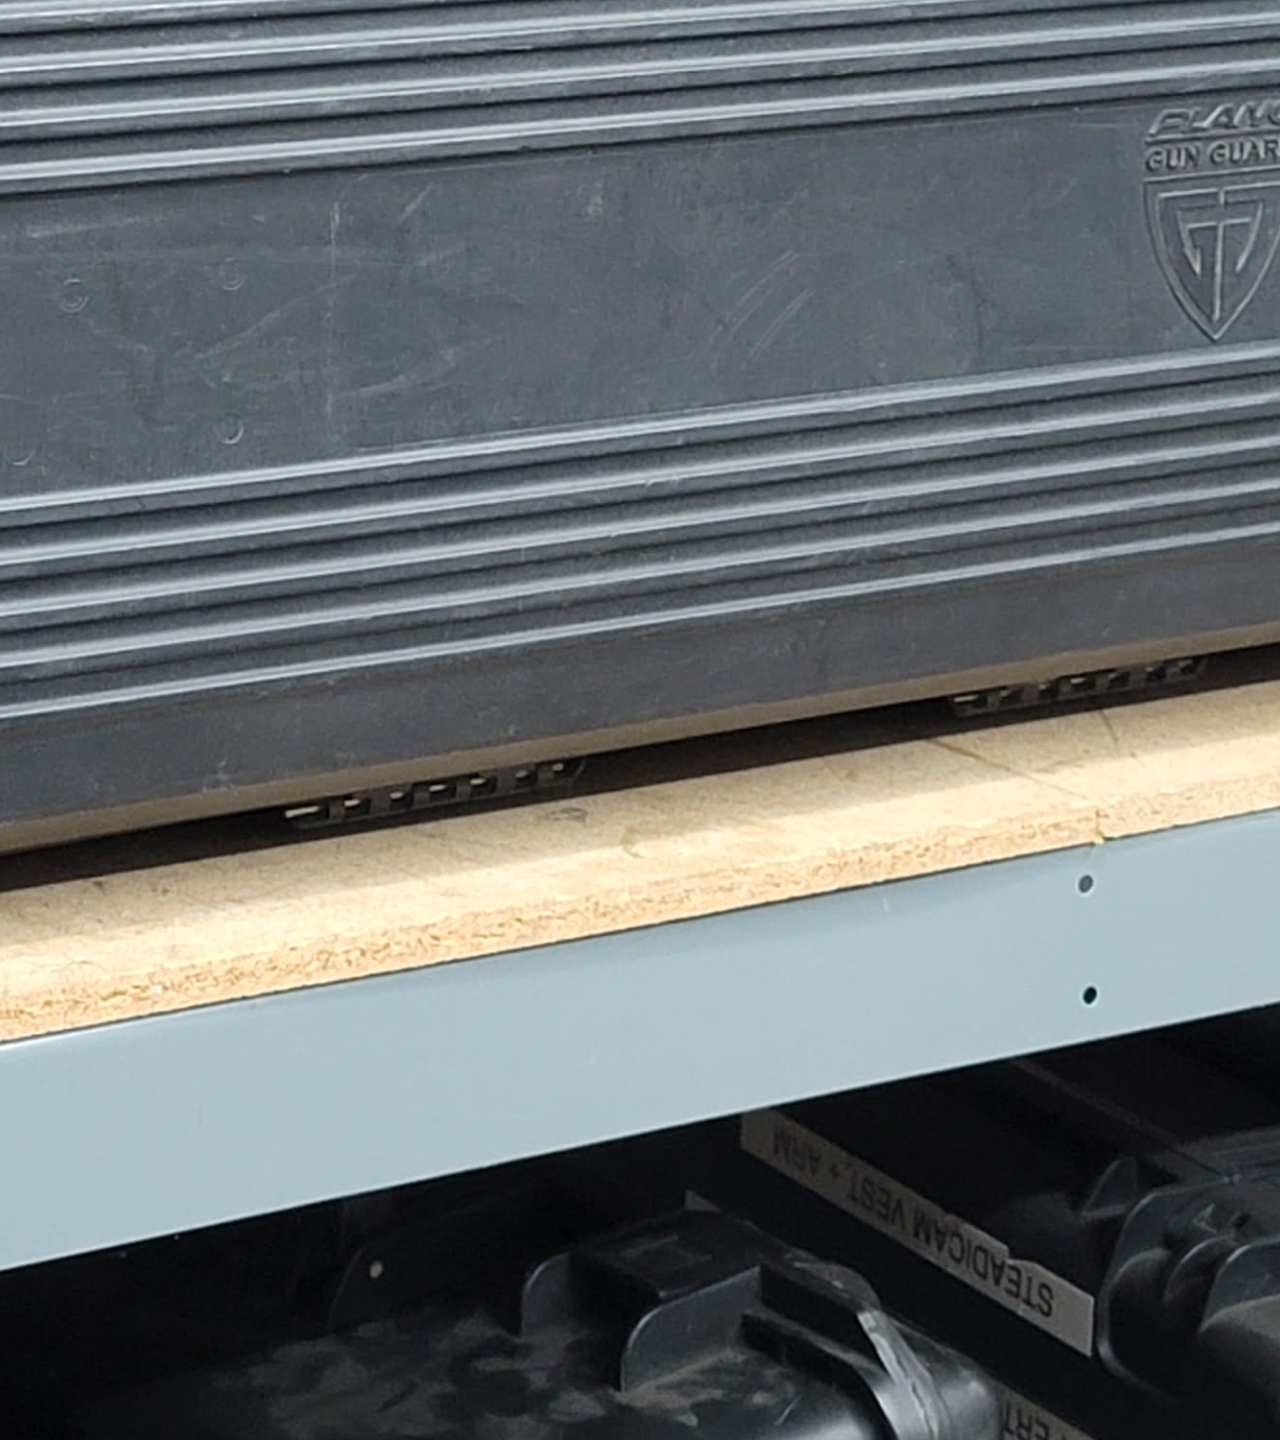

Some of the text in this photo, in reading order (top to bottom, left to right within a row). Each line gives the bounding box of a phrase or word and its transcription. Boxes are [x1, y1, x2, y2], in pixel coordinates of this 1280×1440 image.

[1145, 144, 1201, 172] GUN
[771, 1121, 823, 1177] ARM
[845, 1174, 906, 1234] VEST
[912, 1205, 1055, 1319] STEADICAM
